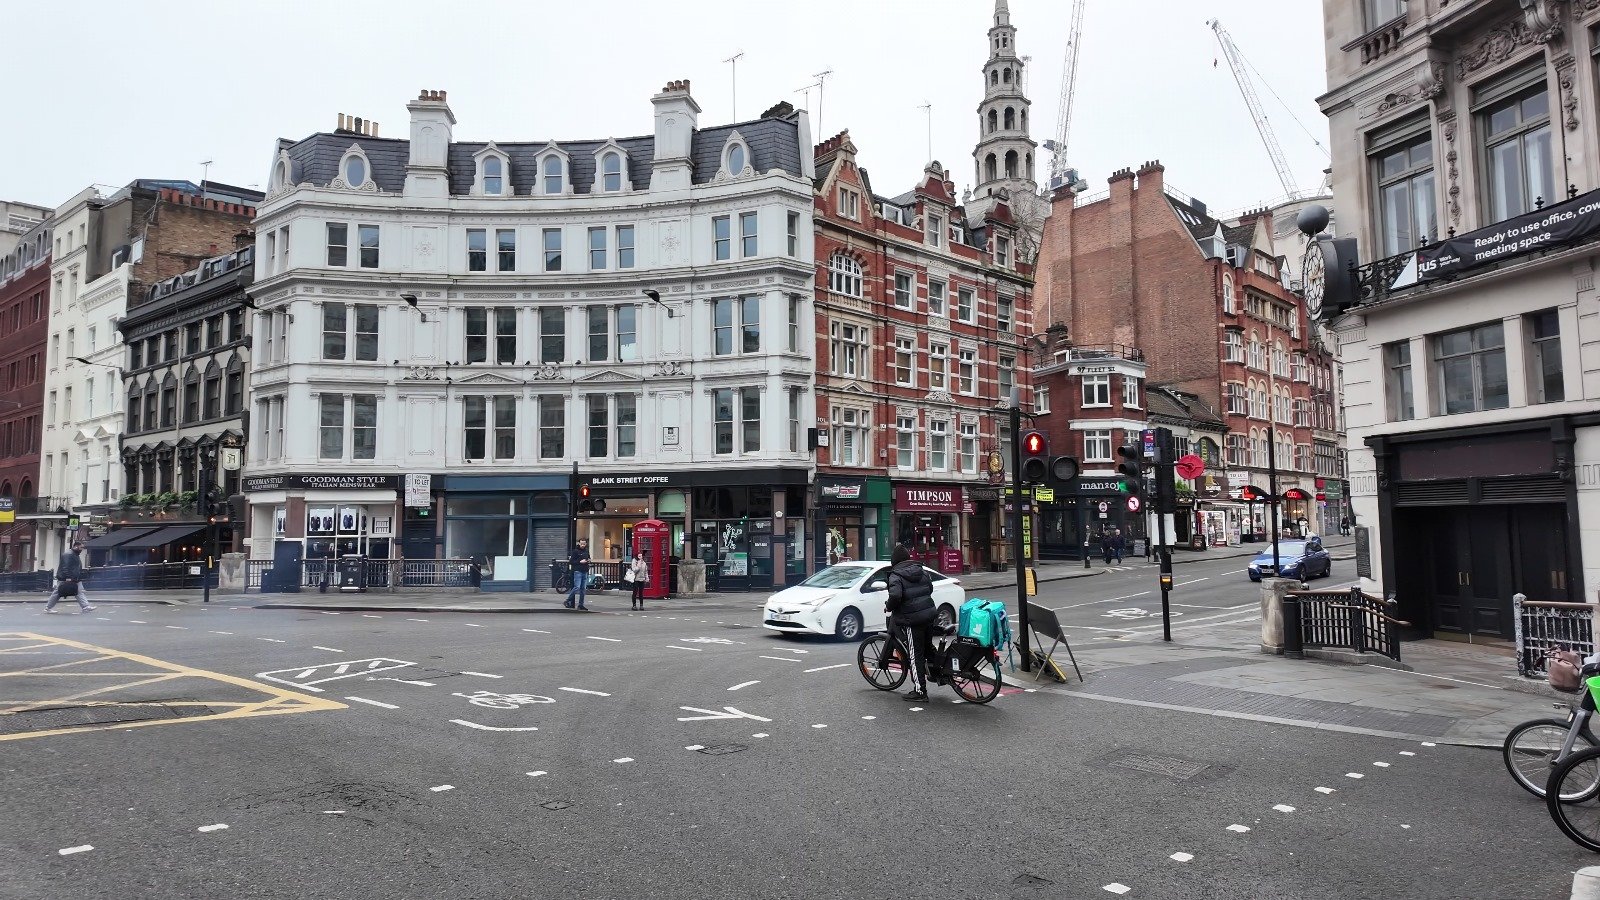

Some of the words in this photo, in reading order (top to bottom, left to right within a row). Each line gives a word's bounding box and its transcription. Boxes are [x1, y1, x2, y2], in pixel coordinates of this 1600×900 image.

[1475, 232, 1505, 248] Ready
[1507, 227, 1519, 237] to
[1521, 222, 1540, 233] use
[1542, 209, 1577, 228] office,
[1475, 240, 1518, 261] meeting
[1519, 231, 1551, 249] space
[906, 490, 952, 502] TIMPSON
